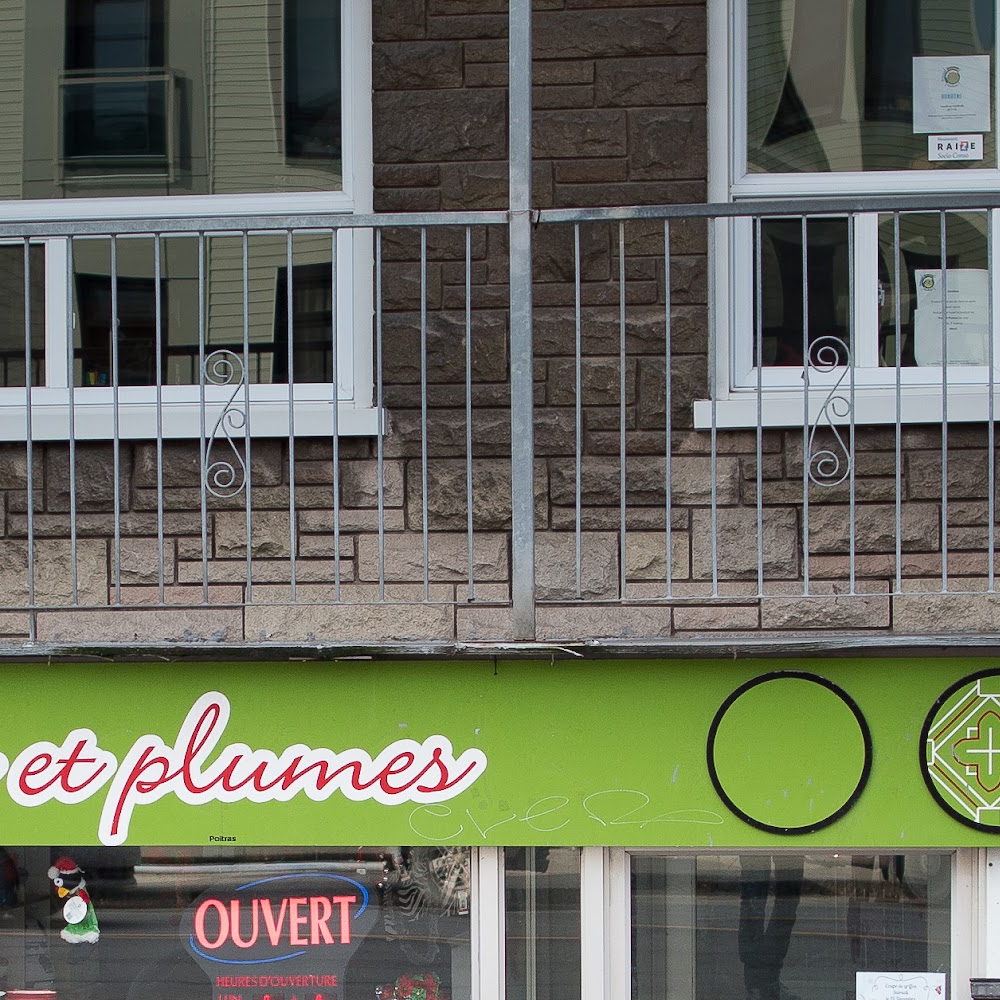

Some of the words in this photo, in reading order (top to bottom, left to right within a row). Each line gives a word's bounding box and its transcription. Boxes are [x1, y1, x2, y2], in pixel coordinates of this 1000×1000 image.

[937, 141, 976, 151] RAIZE
[18, 738, 104, 797] et
[100, 702, 477, 837] plumes
[194, 896, 357, 949] OUVERT
[216, 976, 258, 987] HEURES
[259, 975, 338, 987] D'OUVERTURE
